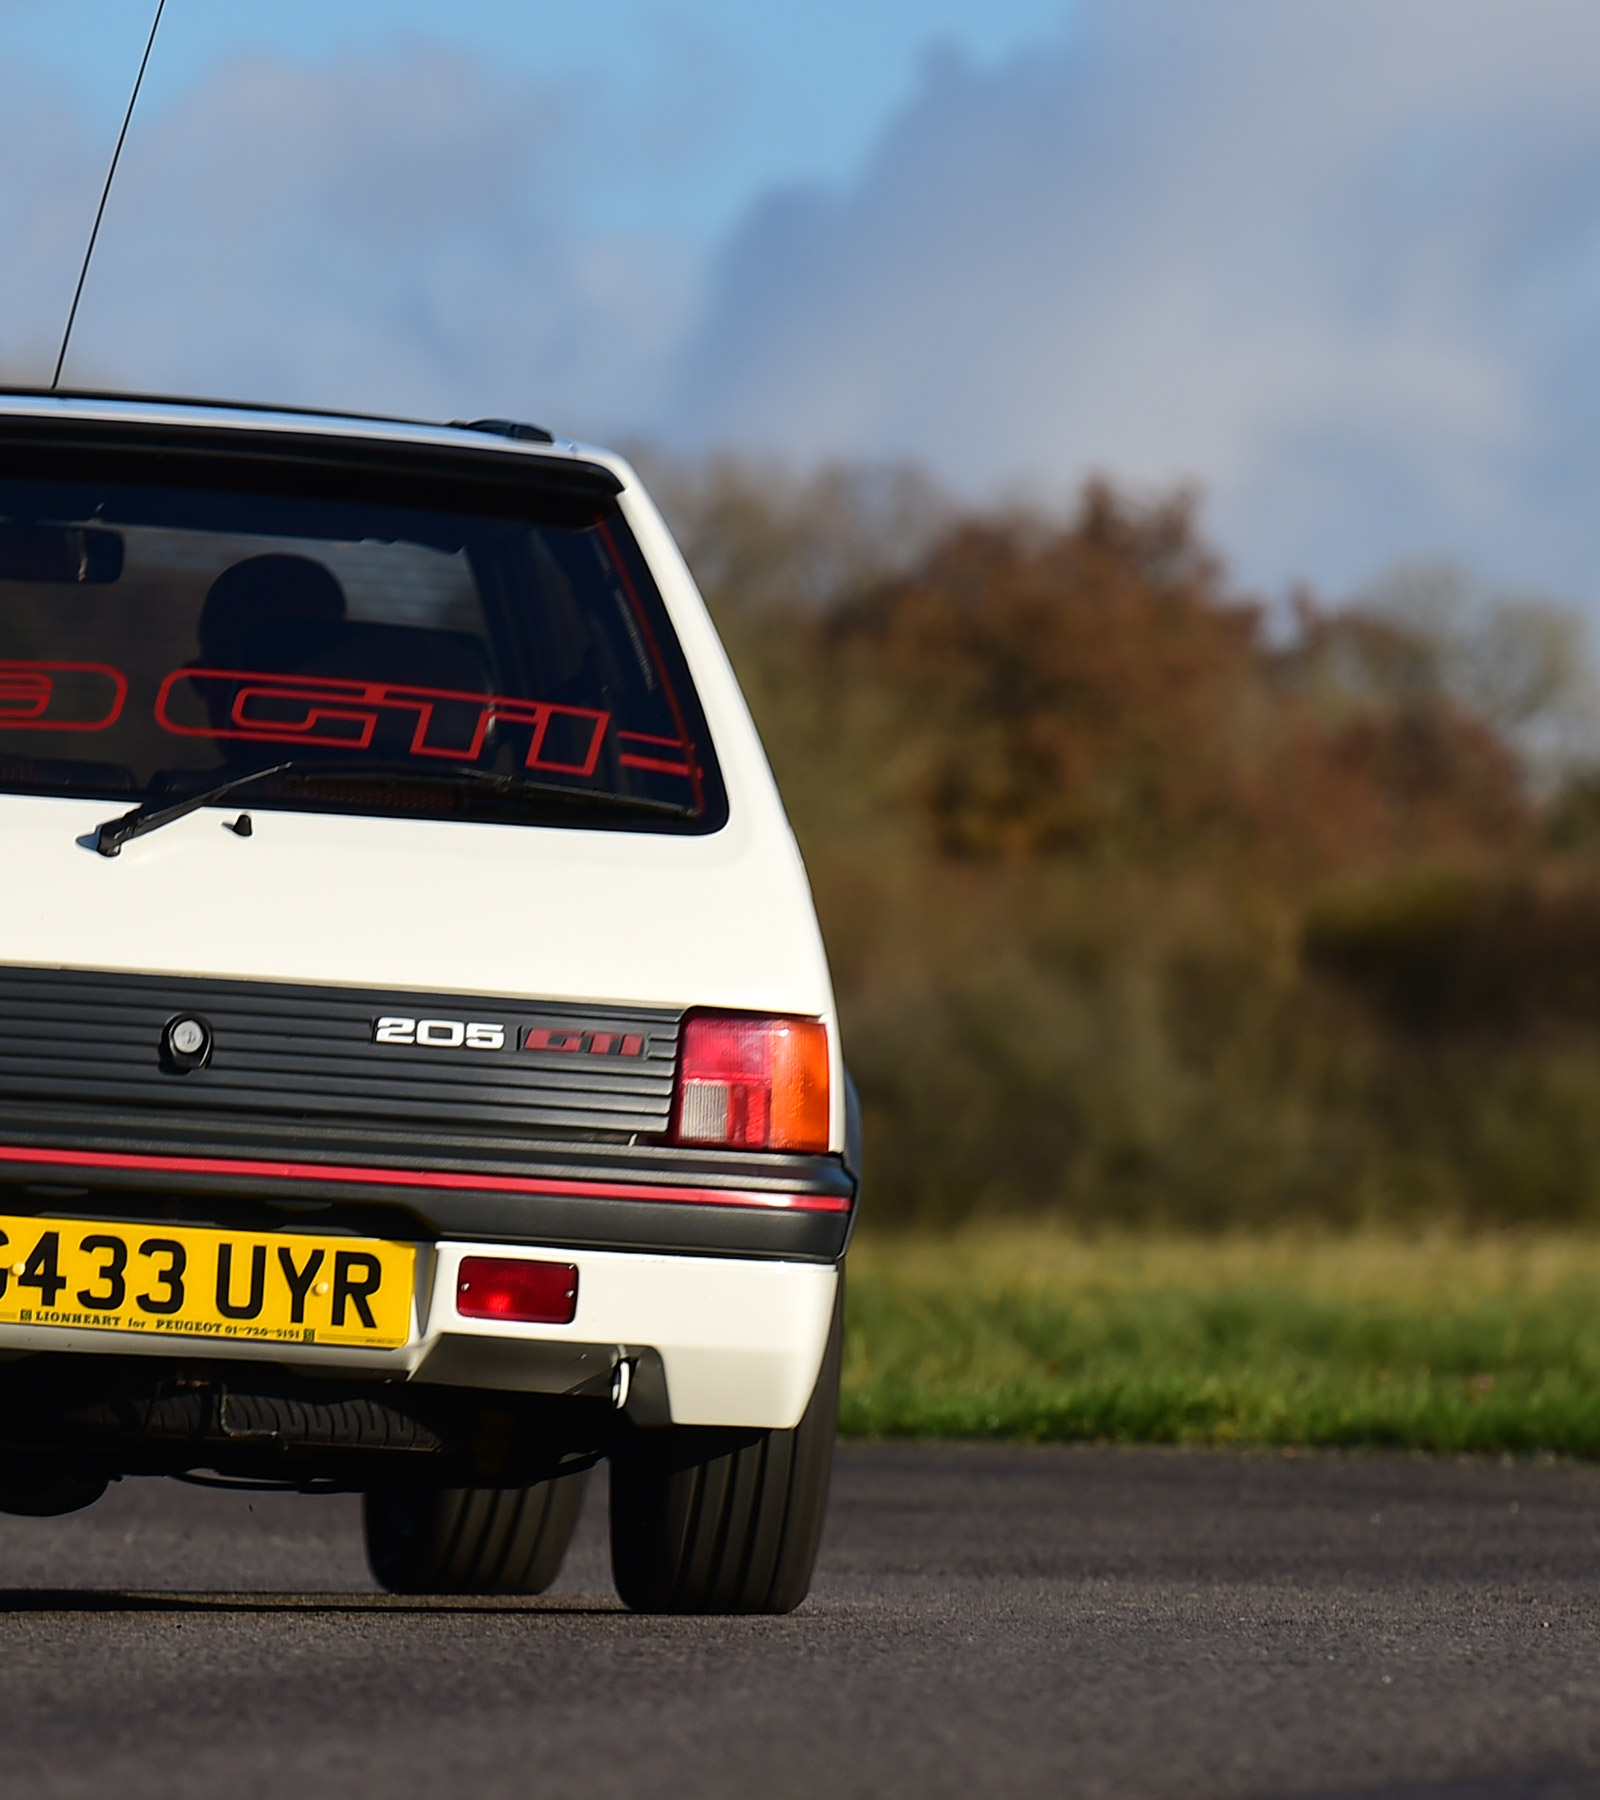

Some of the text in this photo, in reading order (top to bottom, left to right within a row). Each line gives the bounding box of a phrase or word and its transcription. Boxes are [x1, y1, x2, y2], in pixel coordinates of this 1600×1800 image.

[376, 1017, 643, 1057] 205 GTI
[216, 1243, 382, 1328] UYR
[35, 1310, 121, 1326] LIONHEART
[156, 1319, 223, 1333] PEUGEOT
